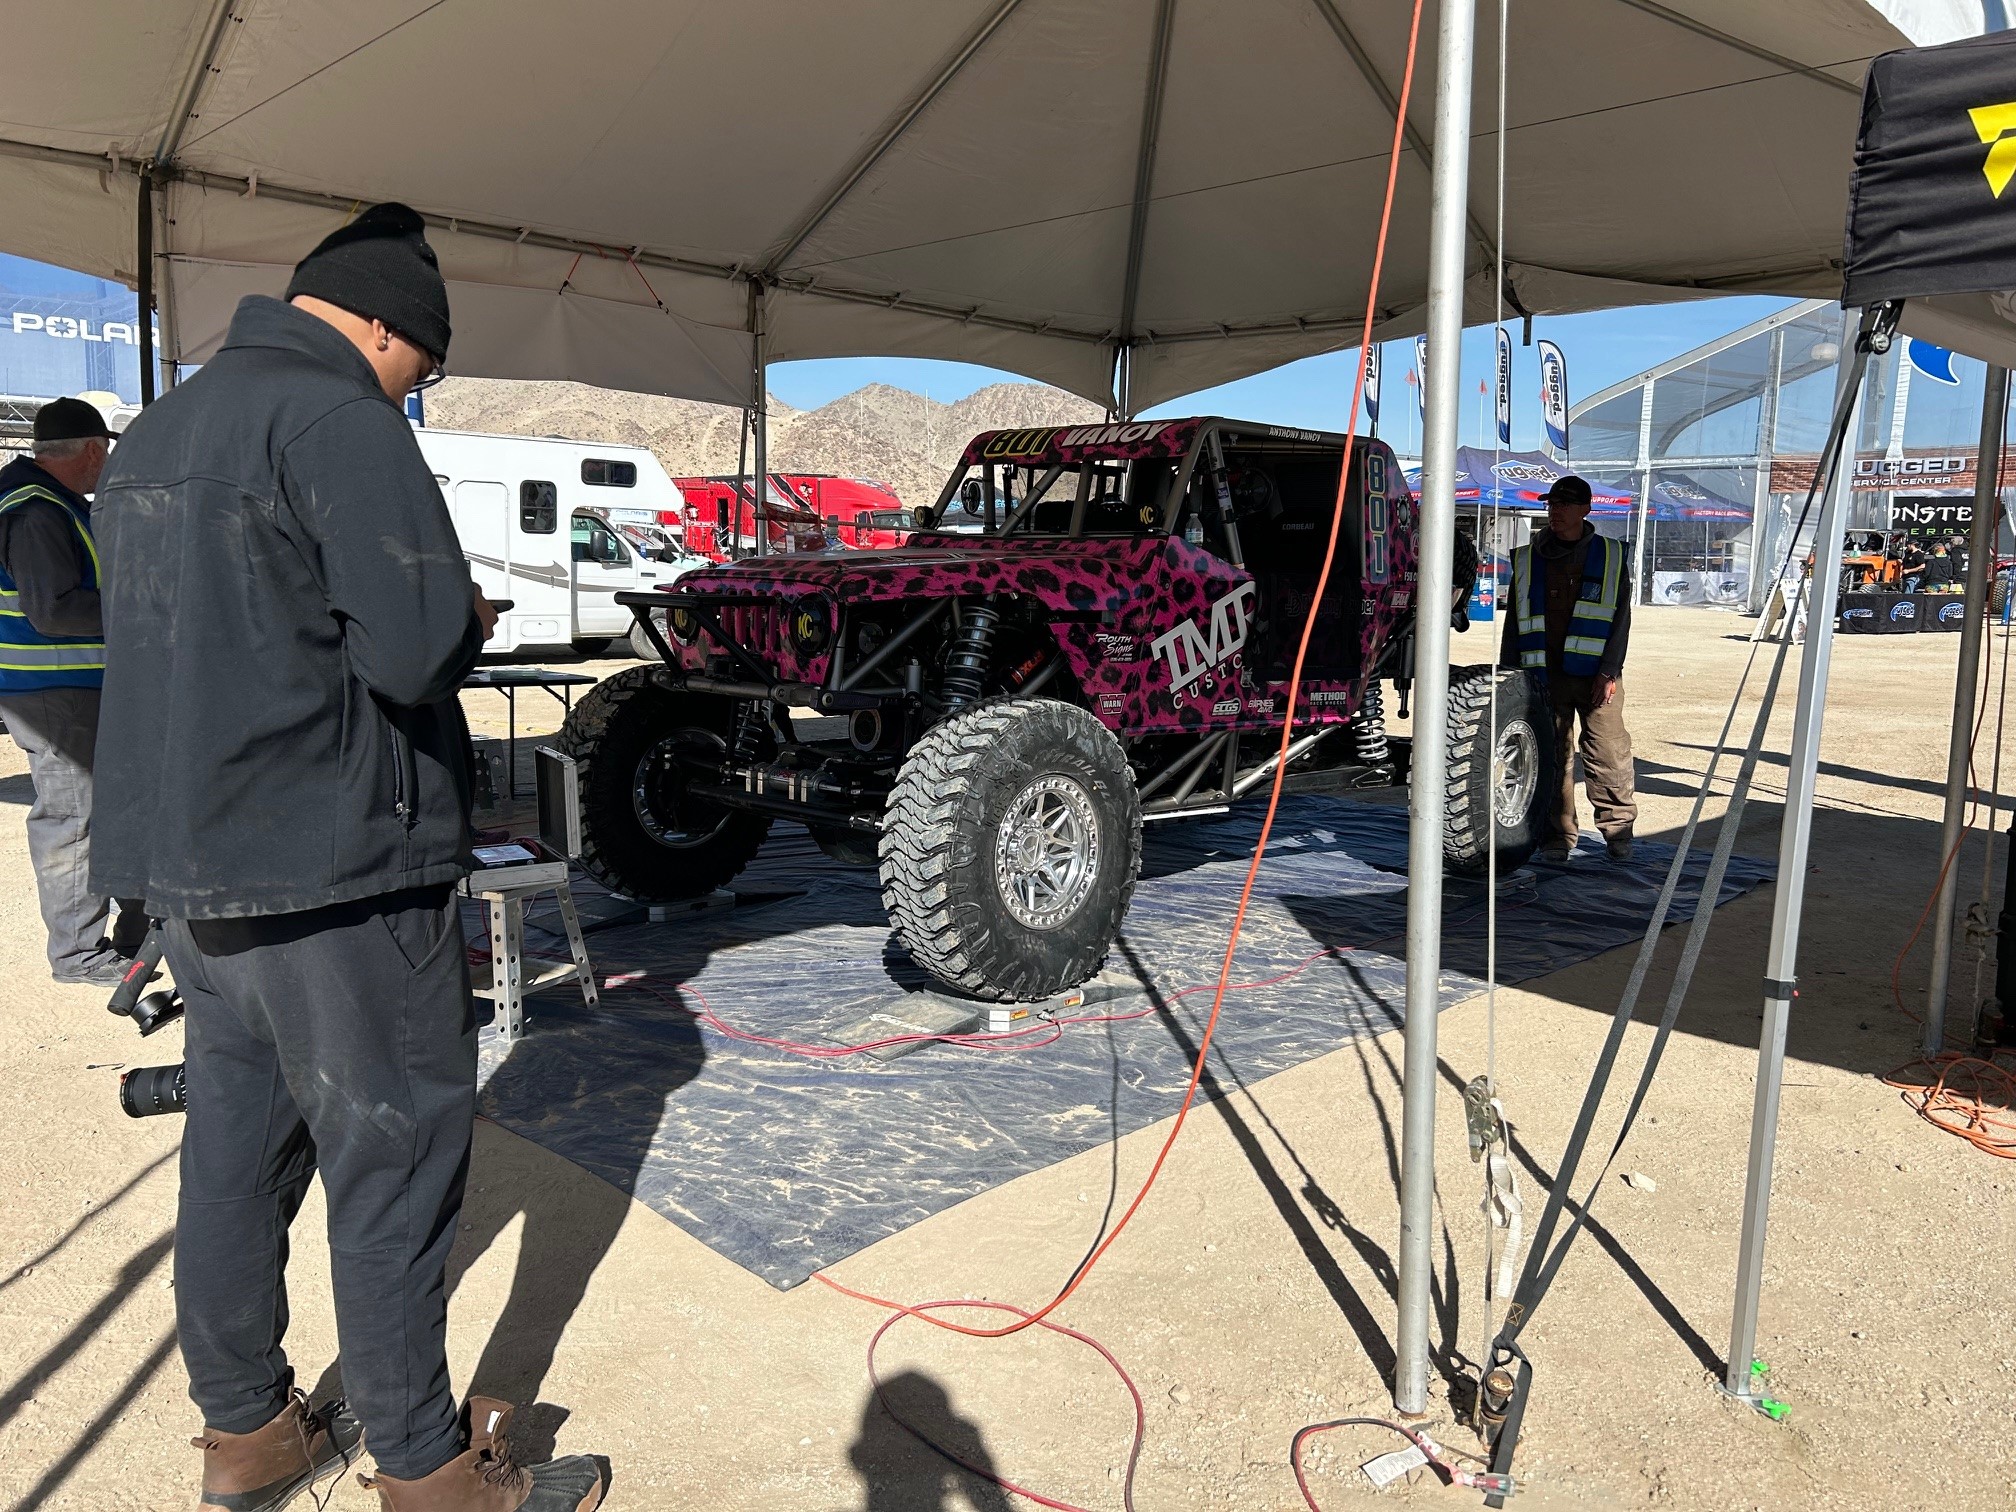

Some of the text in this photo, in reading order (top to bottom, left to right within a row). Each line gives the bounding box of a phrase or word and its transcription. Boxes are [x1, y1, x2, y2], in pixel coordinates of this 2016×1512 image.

[13, 312, 160, 347] POLAR
[1549, 359, 1562, 416] rugged.
[1061, 423, 1174, 447] VANOY
[1268, 427, 1322, 442] ANTHONY VANOY
[1852, 457, 1966, 476] UGGED
[1851, 477, 1952, 487] ERVICE CENTER
[1139, 505, 1154, 525] KC
[1367, 454, 1387, 574] 801
[1282, 523, 1315, 531] CORBEAU
[797, 612, 813, 639] KC
[1103, 700, 1121, 708] WARN
[1310, 692, 1347, 701] METHOD
[1213, 703, 1239, 713] ECGS
